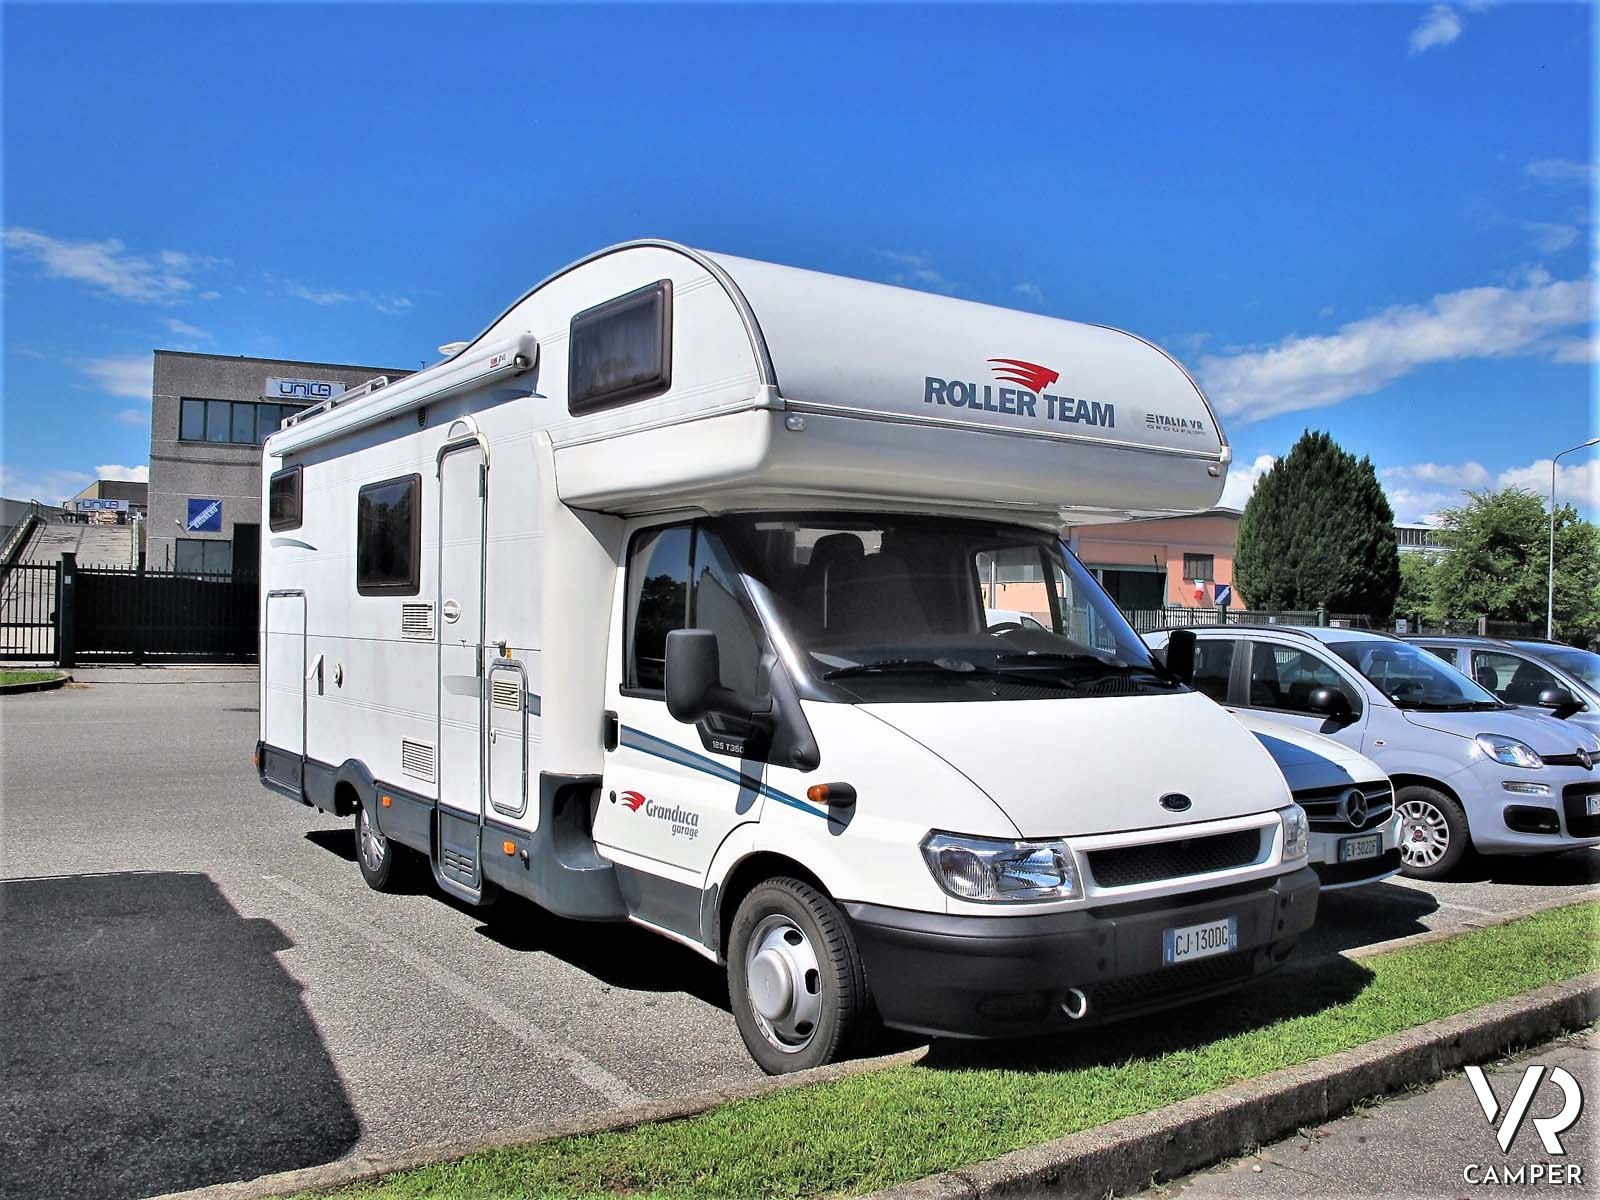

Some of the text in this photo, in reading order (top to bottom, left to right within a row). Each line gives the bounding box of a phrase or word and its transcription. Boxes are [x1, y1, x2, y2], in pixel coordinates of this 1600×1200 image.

[924, 376, 1115, 428] ROLLER TEAM
[1155, 414, 1204, 430] ITALIA VR
[712, 740, 724, 750] 125
[646, 799, 699, 827] Granduca
[671, 823, 699, 840] garage
